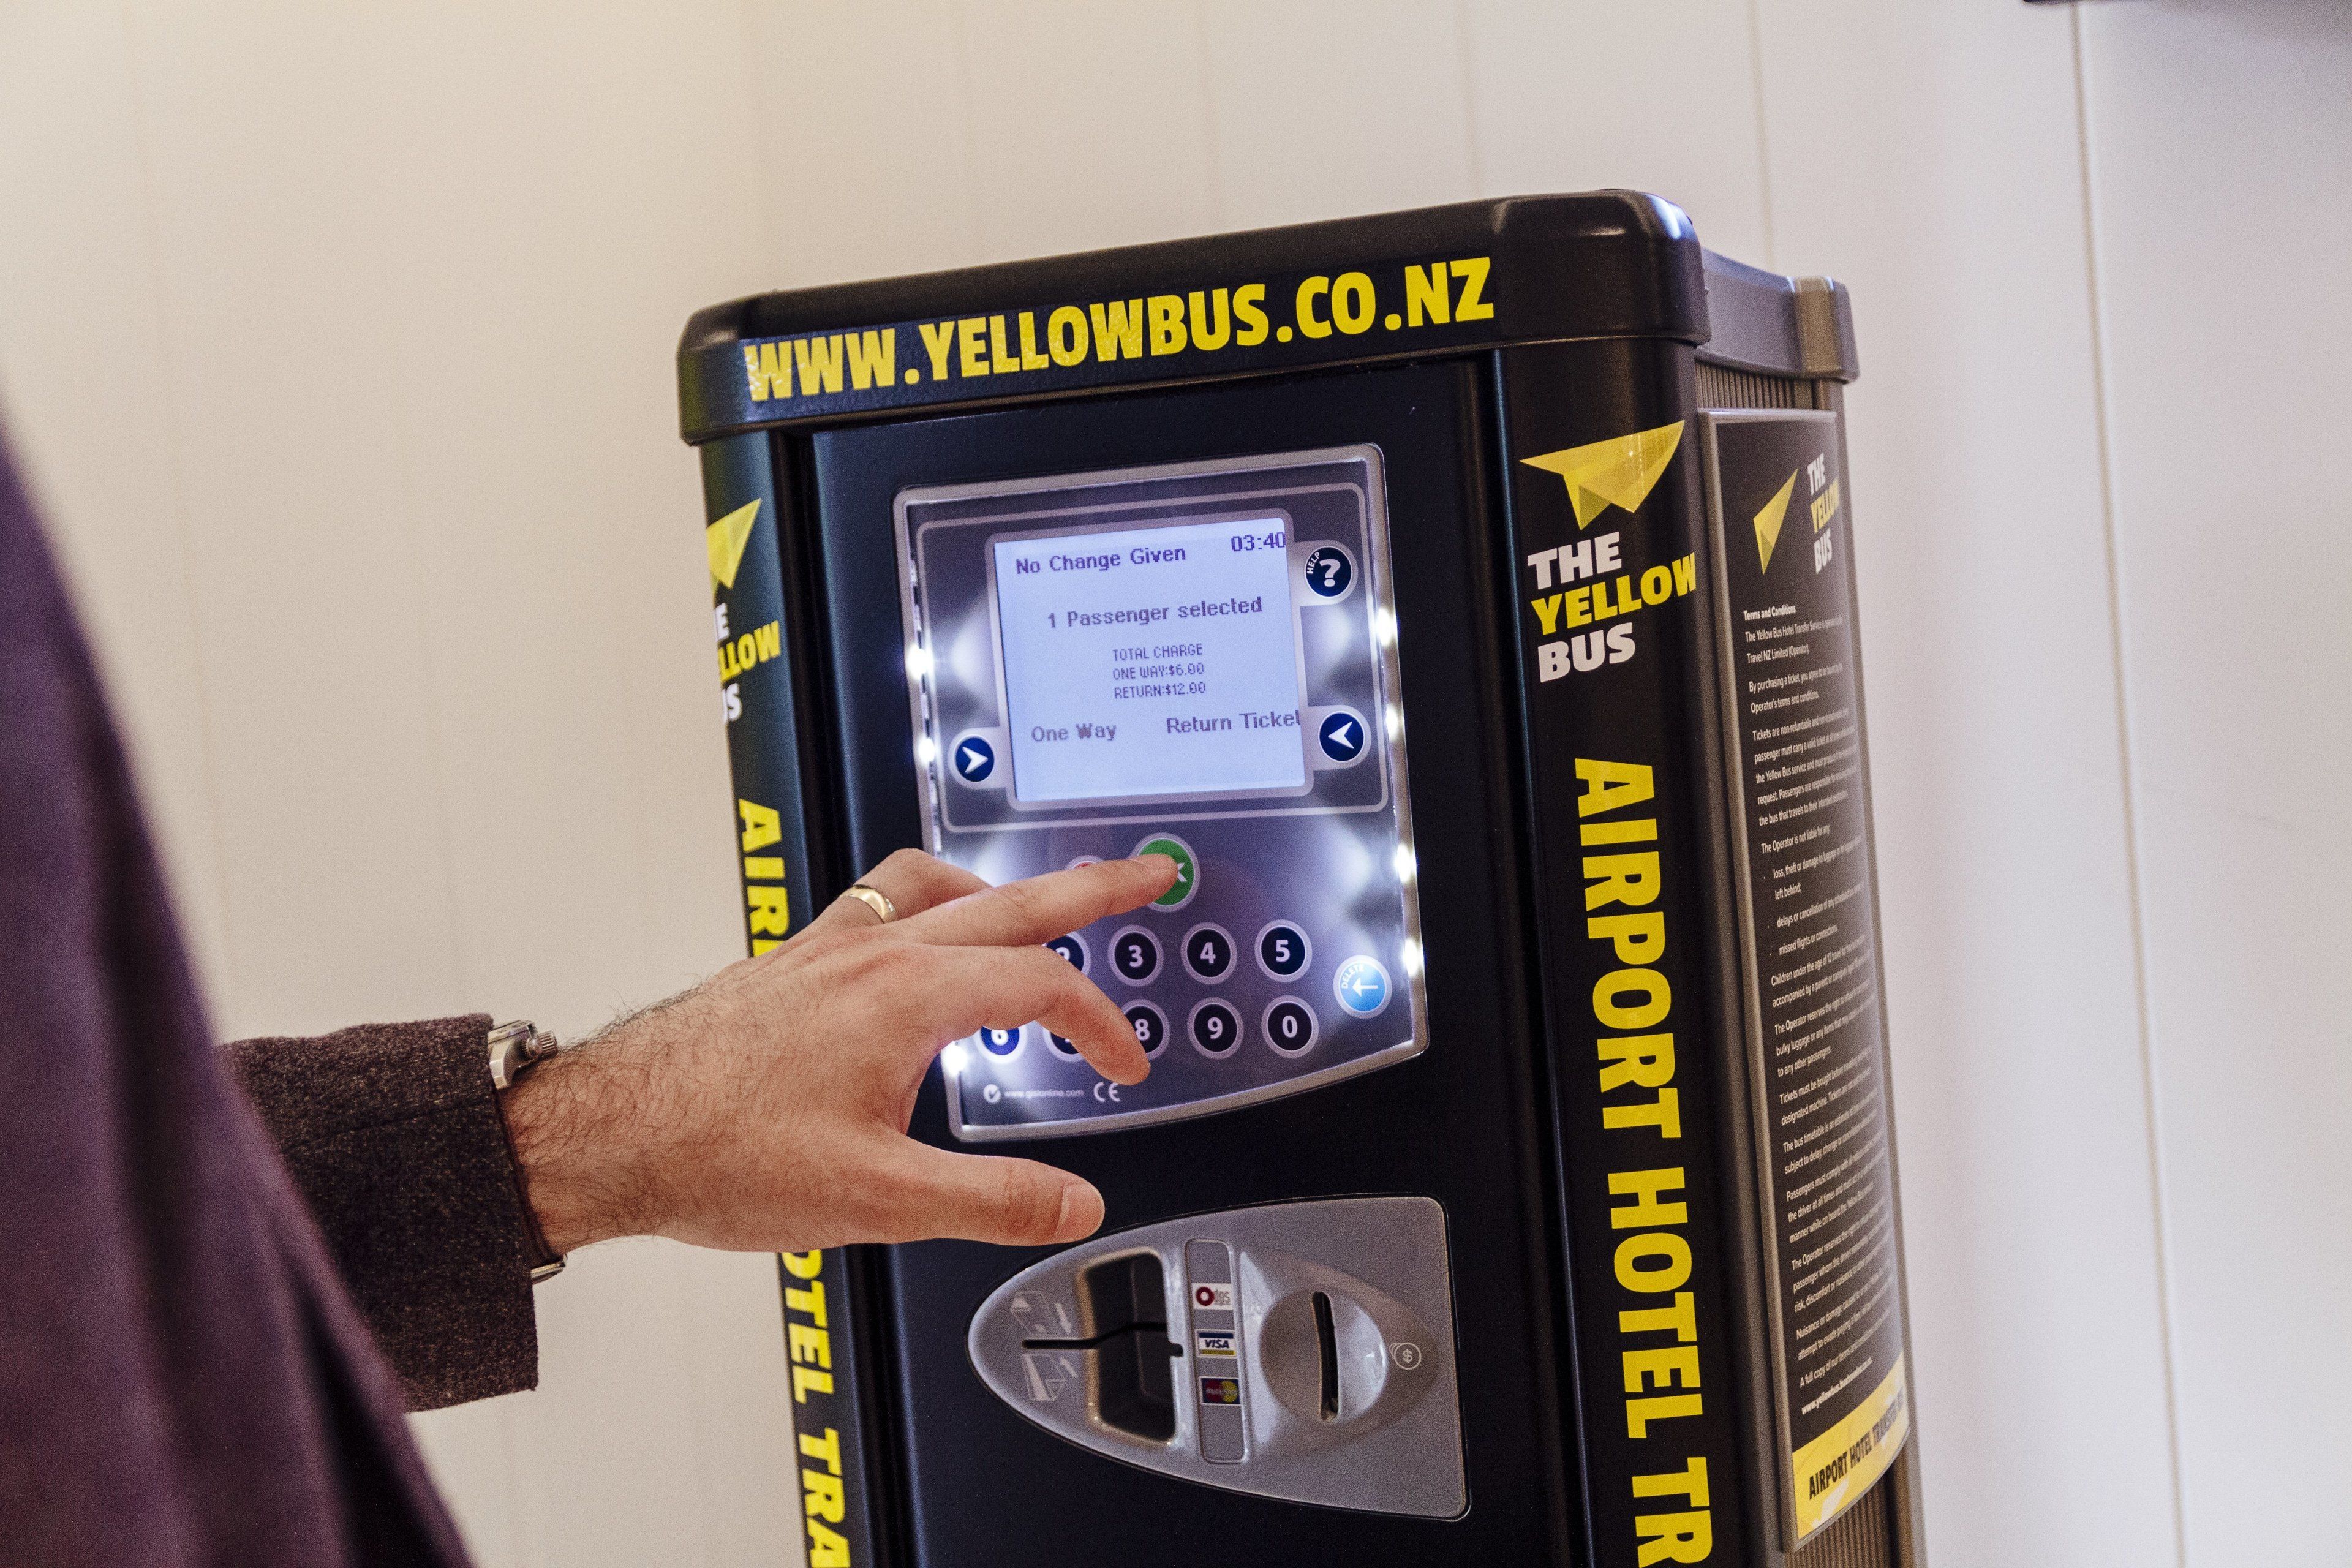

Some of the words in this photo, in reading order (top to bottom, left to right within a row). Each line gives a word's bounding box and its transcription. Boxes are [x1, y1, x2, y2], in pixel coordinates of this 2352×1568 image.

[744, 257, 1494, 402] WWW.YELLOWBUS.CO.NZ
[1807, 453, 1826, 496] THE
[1231, 532, 1286, 551] 03:40
[1814, 527, 1832, 575] BUS
[1017, 559, 1040, 575] No
[1050, 554, 1121, 571] Change
[1131, 546, 1186, 565] Given
[1307, 552, 1319, 574] HELP
[1528, 531, 1622, 590] THE
[1531, 552, 1697, 635] YELLOW
[1048, 613, 1056, 628] 1
[1068, 606, 1169, 627] Passenger
[1178, 597, 1262, 617] selected
[1114, 648, 1150, 662] TOTAL
[1154, 643, 1203, 658] CHARGE
[1537, 622, 1635, 683] BUS
[1113, 668, 1136, 680] ONE
[1140, 662, 1204, 678] WAY:$6.00
[1115, 681, 1206, 699] RETURN:$12.00
[1031, 727, 1068, 742] One
[1076, 723, 1117, 741] Way
[1167, 717, 1232, 734] Return
[1129, 945, 1144, 968] 3
[1200, 942, 1216, 964] 4
[1276, 939, 1291, 962] 5
[1575, 758, 1681, 1138] AIRPORT
[1341, 964, 1364, 989] DELETE
[1135, 1019, 1150, 1041] 8
[1208, 1017, 1223, 1039] 9
[1282, 1015, 1298, 1038] 0
[1608, 1167, 1703, 1439] HOTEL
[1204, 1339, 1230, 1349] VISA
[1809, 1451, 1847, 1500] AIRPORT
[1849, 1431, 1872, 1469] HOTEL
